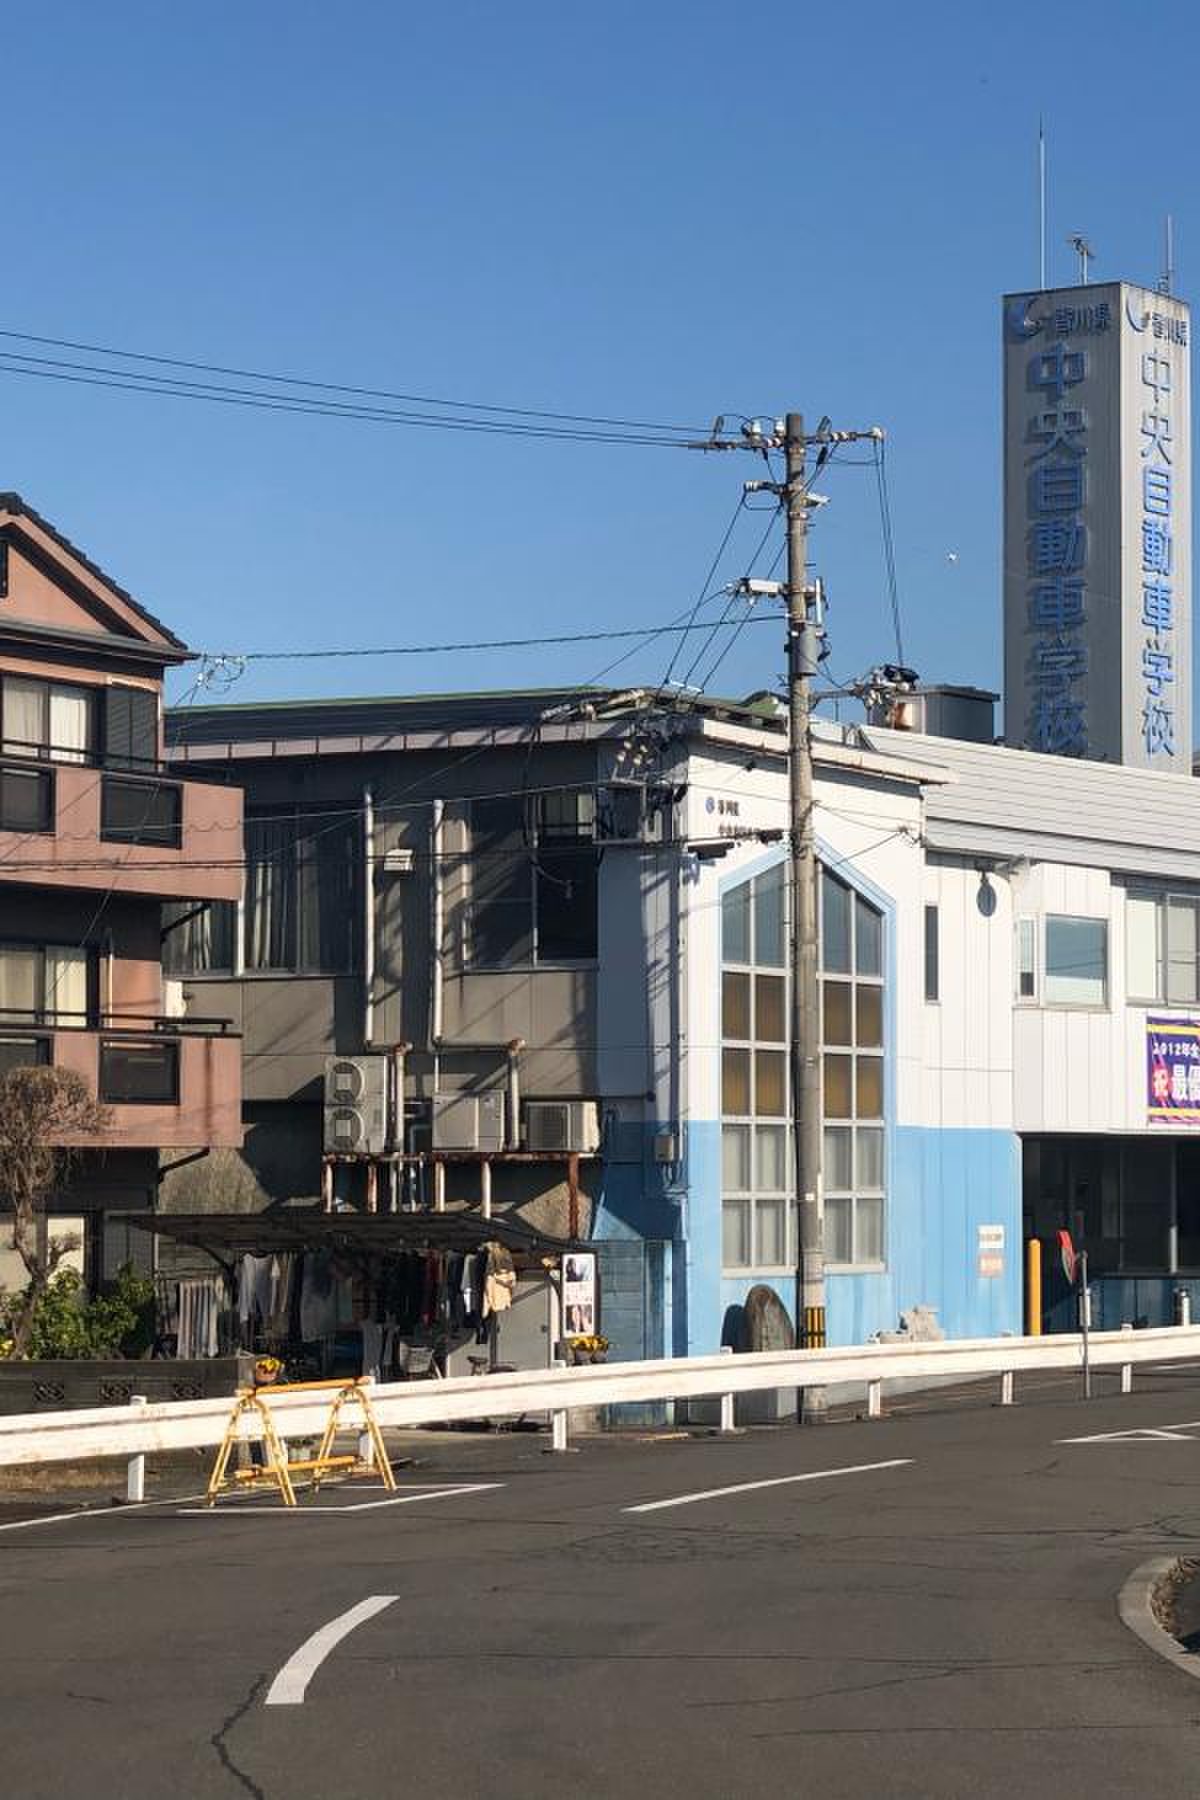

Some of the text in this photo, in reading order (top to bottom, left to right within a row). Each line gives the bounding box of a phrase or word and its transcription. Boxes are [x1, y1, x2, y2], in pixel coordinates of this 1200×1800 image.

[1030, 341, 1088, 755] 中央自動車学校
[1140, 350, 1173, 758] 中央自動車学校
